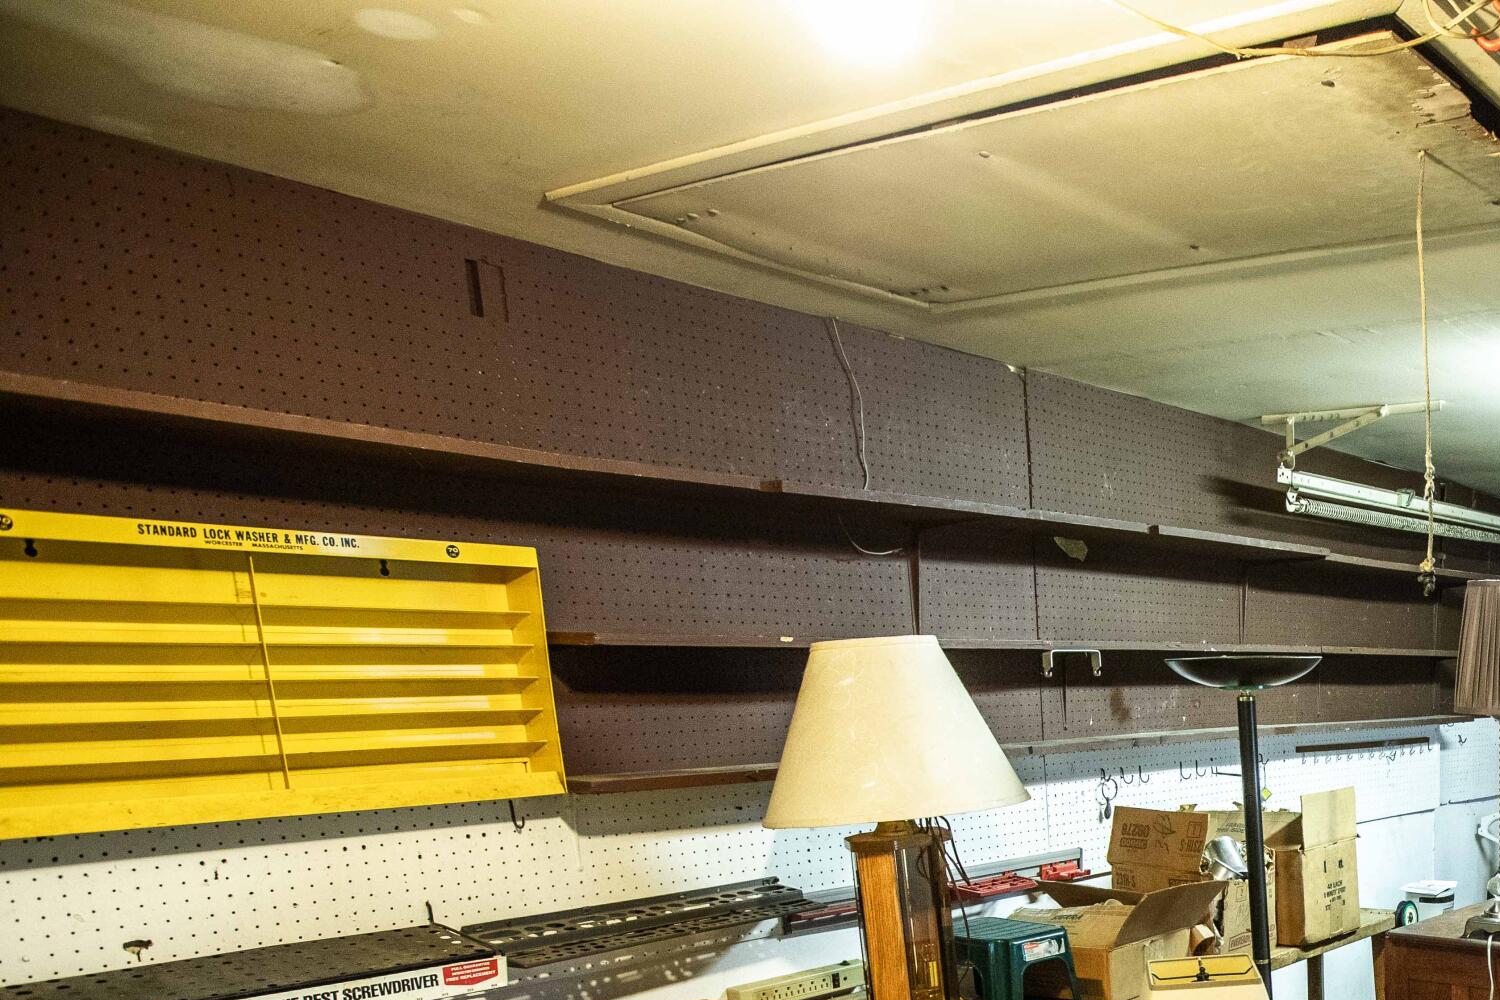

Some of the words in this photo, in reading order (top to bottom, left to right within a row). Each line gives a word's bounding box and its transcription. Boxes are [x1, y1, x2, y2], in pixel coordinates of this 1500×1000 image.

[137, 523, 197, 538] STANDARD
[203, 528, 231, 540] LOCK
[235, 530, 279, 543] WASHER
[284, 534, 291, 544] &
[295, 534, 320, 546] MFG.
[322, 536, 339, 547] CO.
[341, 537, 360, 549] INC.
[251, 543, 304, 551] MASSACHUSETTS
